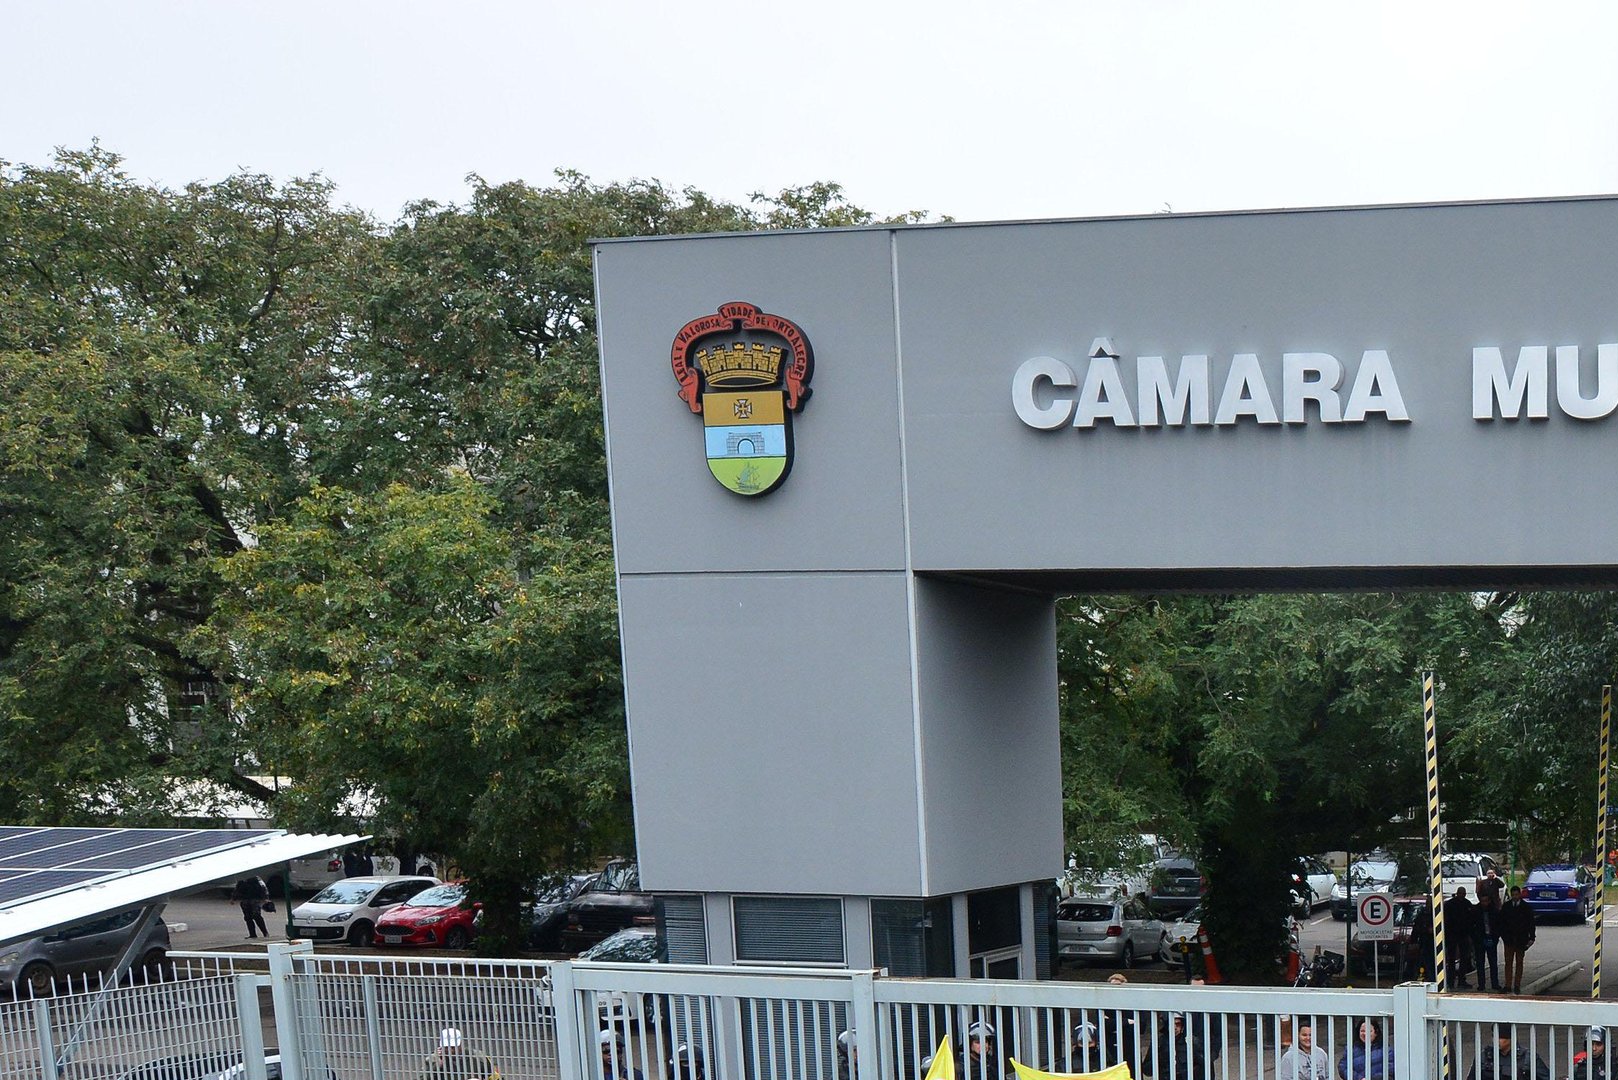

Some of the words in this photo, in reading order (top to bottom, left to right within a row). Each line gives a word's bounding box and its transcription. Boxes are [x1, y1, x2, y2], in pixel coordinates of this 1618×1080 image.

[720, 306, 753, 319] CIDADE
[756, 316, 766, 326] DE
[678, 318, 721, 343] VALOROSA
[674, 355, 688, 383] LEAL
[1011, 337, 1411, 431] CÂMARA
[1370, 901, 1382, 919] E
